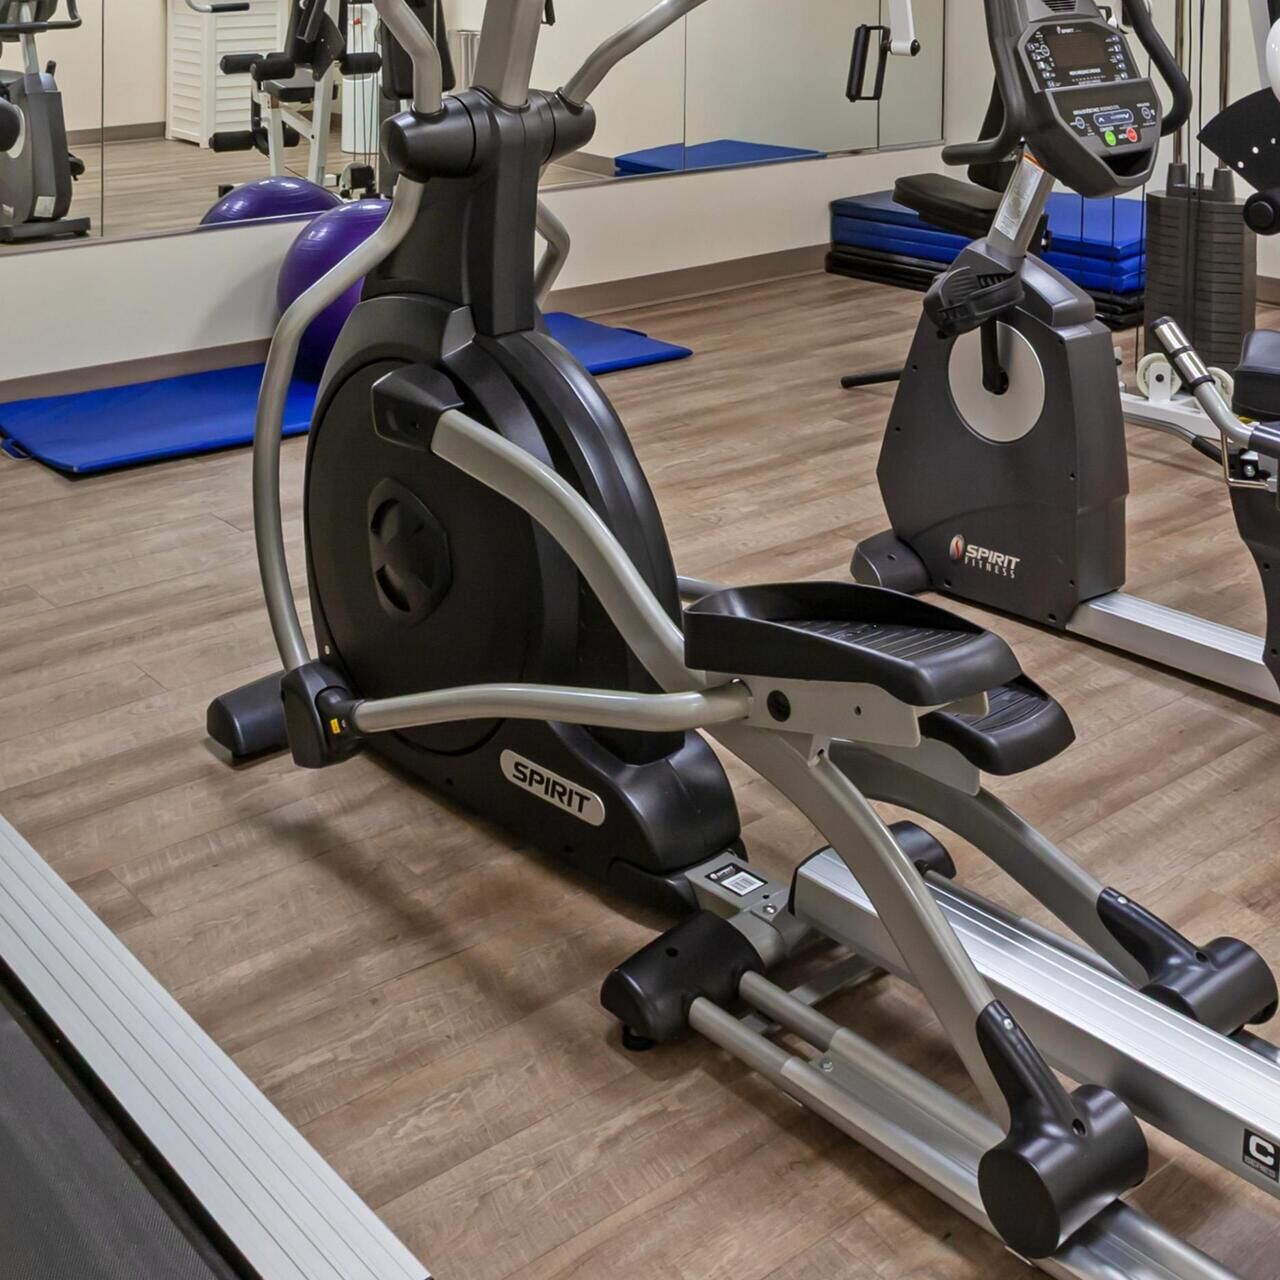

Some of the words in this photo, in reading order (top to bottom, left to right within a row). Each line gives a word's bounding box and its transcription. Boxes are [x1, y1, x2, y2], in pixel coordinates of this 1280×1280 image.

[964, 556, 1015, 579] FITNESS
[965, 544, 1021, 570] SPIRIT
[512, 761, 591, 814] SPIRIT
